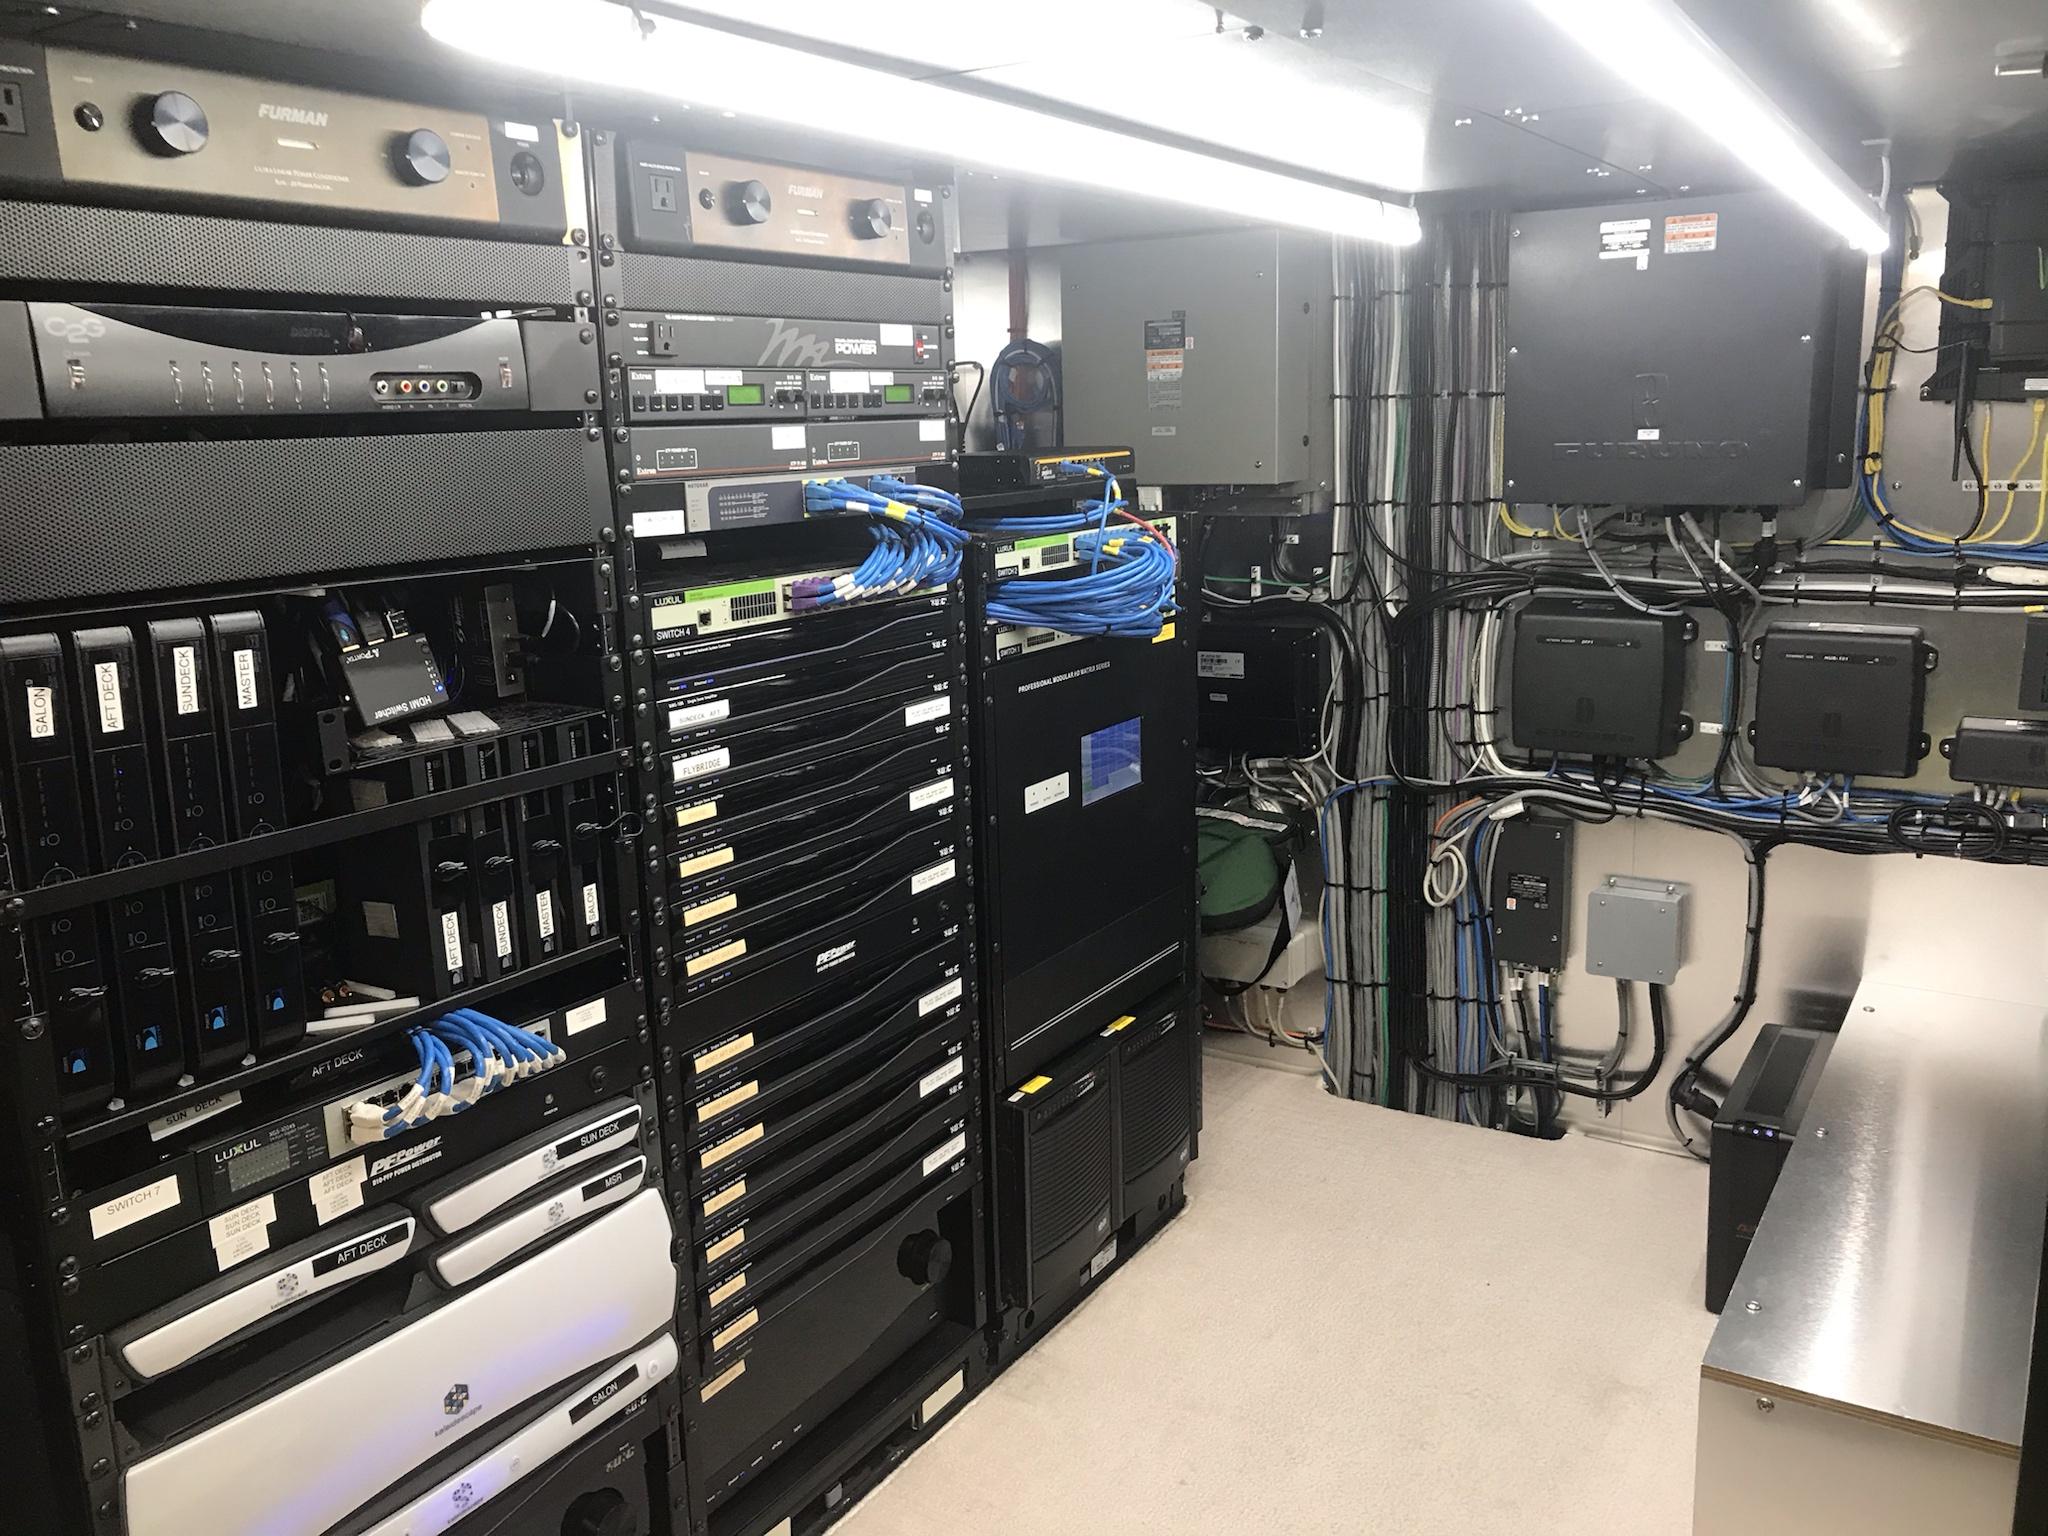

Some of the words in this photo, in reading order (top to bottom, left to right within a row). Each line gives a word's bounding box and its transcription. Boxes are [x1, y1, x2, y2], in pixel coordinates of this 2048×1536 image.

[259, 103, 328, 127] FURMAN
[44, 317, 106, 344] C2G
[835, 343, 878, 355] POWER
[1553, 442, 1751, 462] FURUNO
[654, 595, 683, 607] LUXUL
[656, 628, 685, 642] SWITCH
[686, 627, 691, 636] 4
[101, 664, 115, 701] DECK
[178, 649, 194, 711] SUNDECK
[239, 653, 253, 706] MASTER
[1018, 677, 1052, 694] PROFESSIONAL
[1052, 671, 1074, 684] MODULAR
[1080, 665, 1095, 676] MATRIX
[1096, 661, 1111, 671] SERIES
[34, 688, 49, 734] SALON
[374, 703, 409, 720] Switcher
[410, 694, 432, 708] HDMI
[106, 705, 119, 729] AFT
[683, 757, 721, 776] FLYBRIDGE
[538, 892, 551, 935] MASTER
[585, 887, 598, 922] SALON
[445, 913, 457, 946] DECK
[494, 903, 509, 956] SUNDECK
[448, 946, 458, 967] AFT
[311, 1060, 332, 1078] AFT
[334, 1048, 363, 1070] DECK
[166, 1111, 187, 1126] SUN
[194, 1095, 223, 1113] DECK
[580, 1131, 598, 1147] SUN
[598, 1121, 620, 1137] DECK
[214, 1139, 262, 1164] LUXUL
[369, 1135, 443, 1177] PFPower
[394, 1164, 412, 1177] POWER
[411, 1150, 443, 1169] DISTRIBUTOR
[322, 1171, 333, 1180] AFT
[335, 1164, 353, 1175] DECK
[323, 1179, 334, 1188] AFT
[335, 1172, 352, 1183] DECK
[604, 1172, 622, 1188] MSR
[324, 1185, 335, 1195] AFT
[336, 1178, 353, 1190] DECK
[106, 1191, 152, 1216] SWITCH
[153, 1186, 161, 1197] 7
[224, 1212, 239, 1224] SUN
[240, 1204, 260, 1216] DECK
[225, 1219, 240, 1231] SUN
[241, 1212, 260, 1224] DECK
[225, 1226, 241, 1239] SUN
[242, 1218, 261, 1231] DECK
[337, 1247, 357, 1265] AFT
[359, 1234, 388, 1256] DECK
[591, 1382, 618, 1406] SALON
